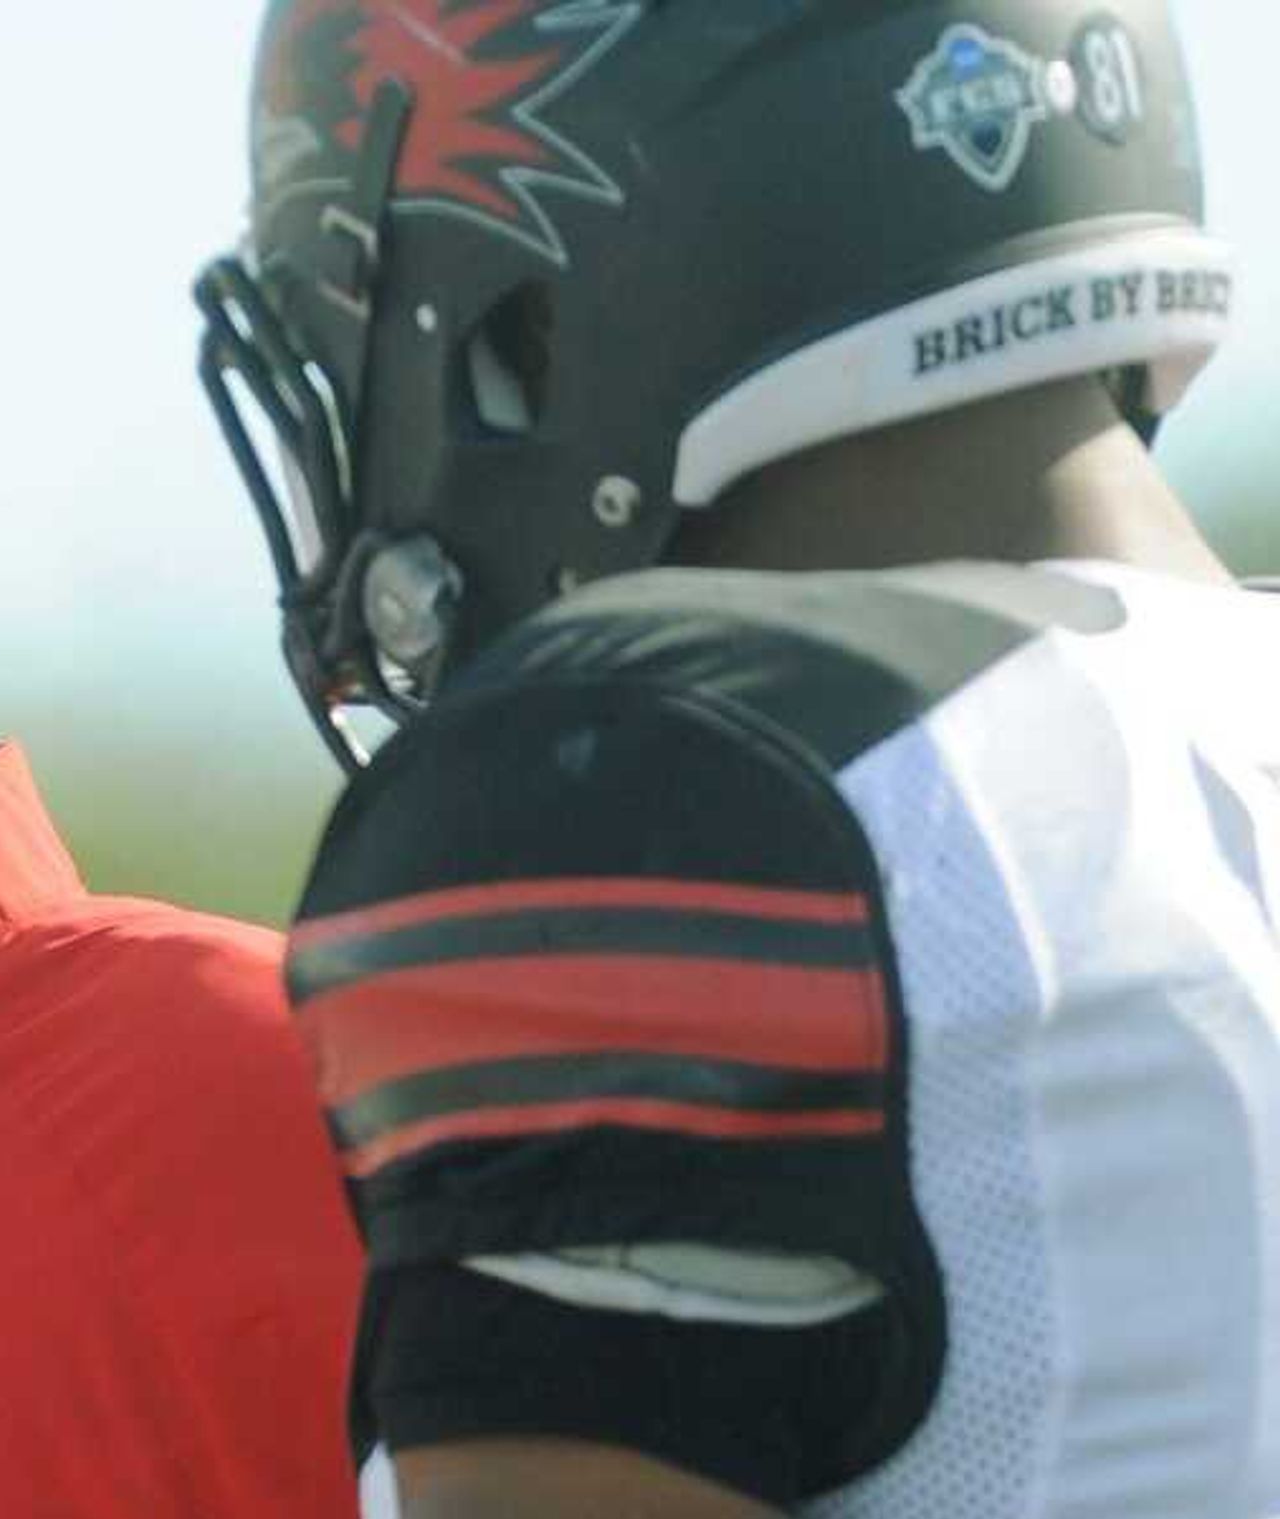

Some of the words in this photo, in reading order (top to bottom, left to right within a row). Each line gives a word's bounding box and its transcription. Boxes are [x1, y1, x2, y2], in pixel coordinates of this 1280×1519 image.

[1083, 26, 1141, 126] 81
[914, 286, 1075, 374] BRICK
[1090, 270, 1144, 320] BY
